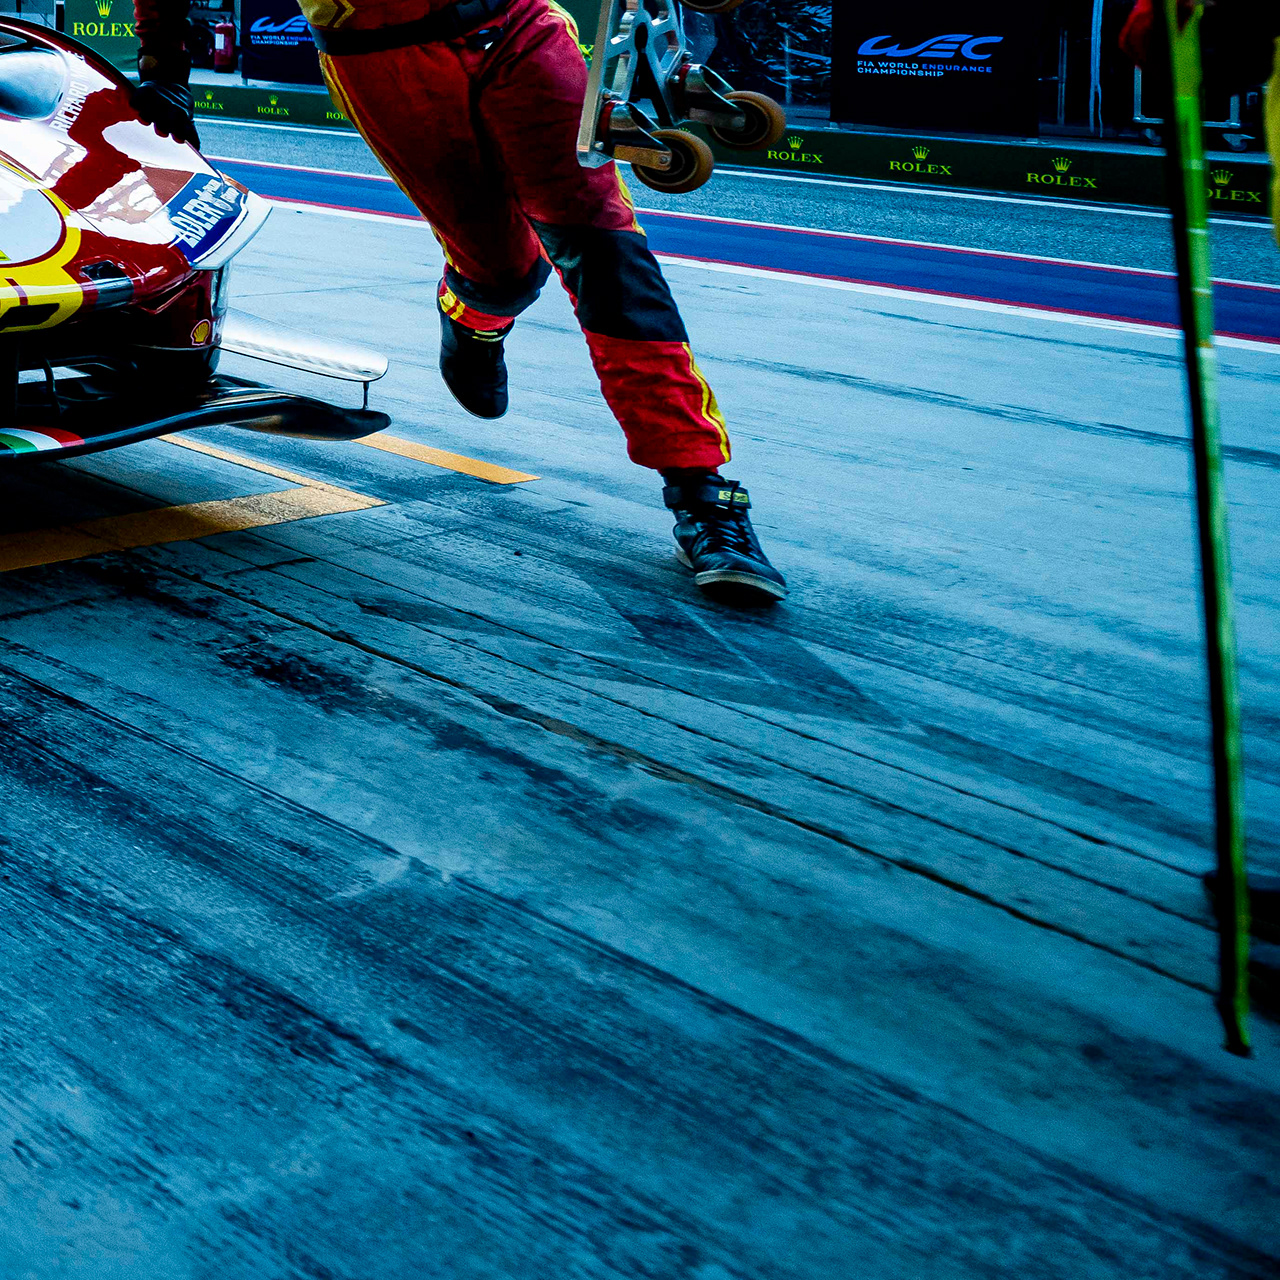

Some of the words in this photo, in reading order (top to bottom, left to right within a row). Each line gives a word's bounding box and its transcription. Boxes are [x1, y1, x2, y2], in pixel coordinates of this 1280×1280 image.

[73, 22, 135, 38] ROLEX
[857, 33, 1004, 60] WEC
[857, 67, 944, 77] CHAMPIONSHIP
[878, 61, 919, 70] WORLD
[922, 63, 993, 73] ENDURANCE
[193, 100, 225, 111] ROLEX
[257, 105, 290, 117] ROLEX
[767, 150, 824, 165] ROLEX
[889, 160, 953, 176] ROLEX
[1026, 172, 1098, 189] ROLEX
